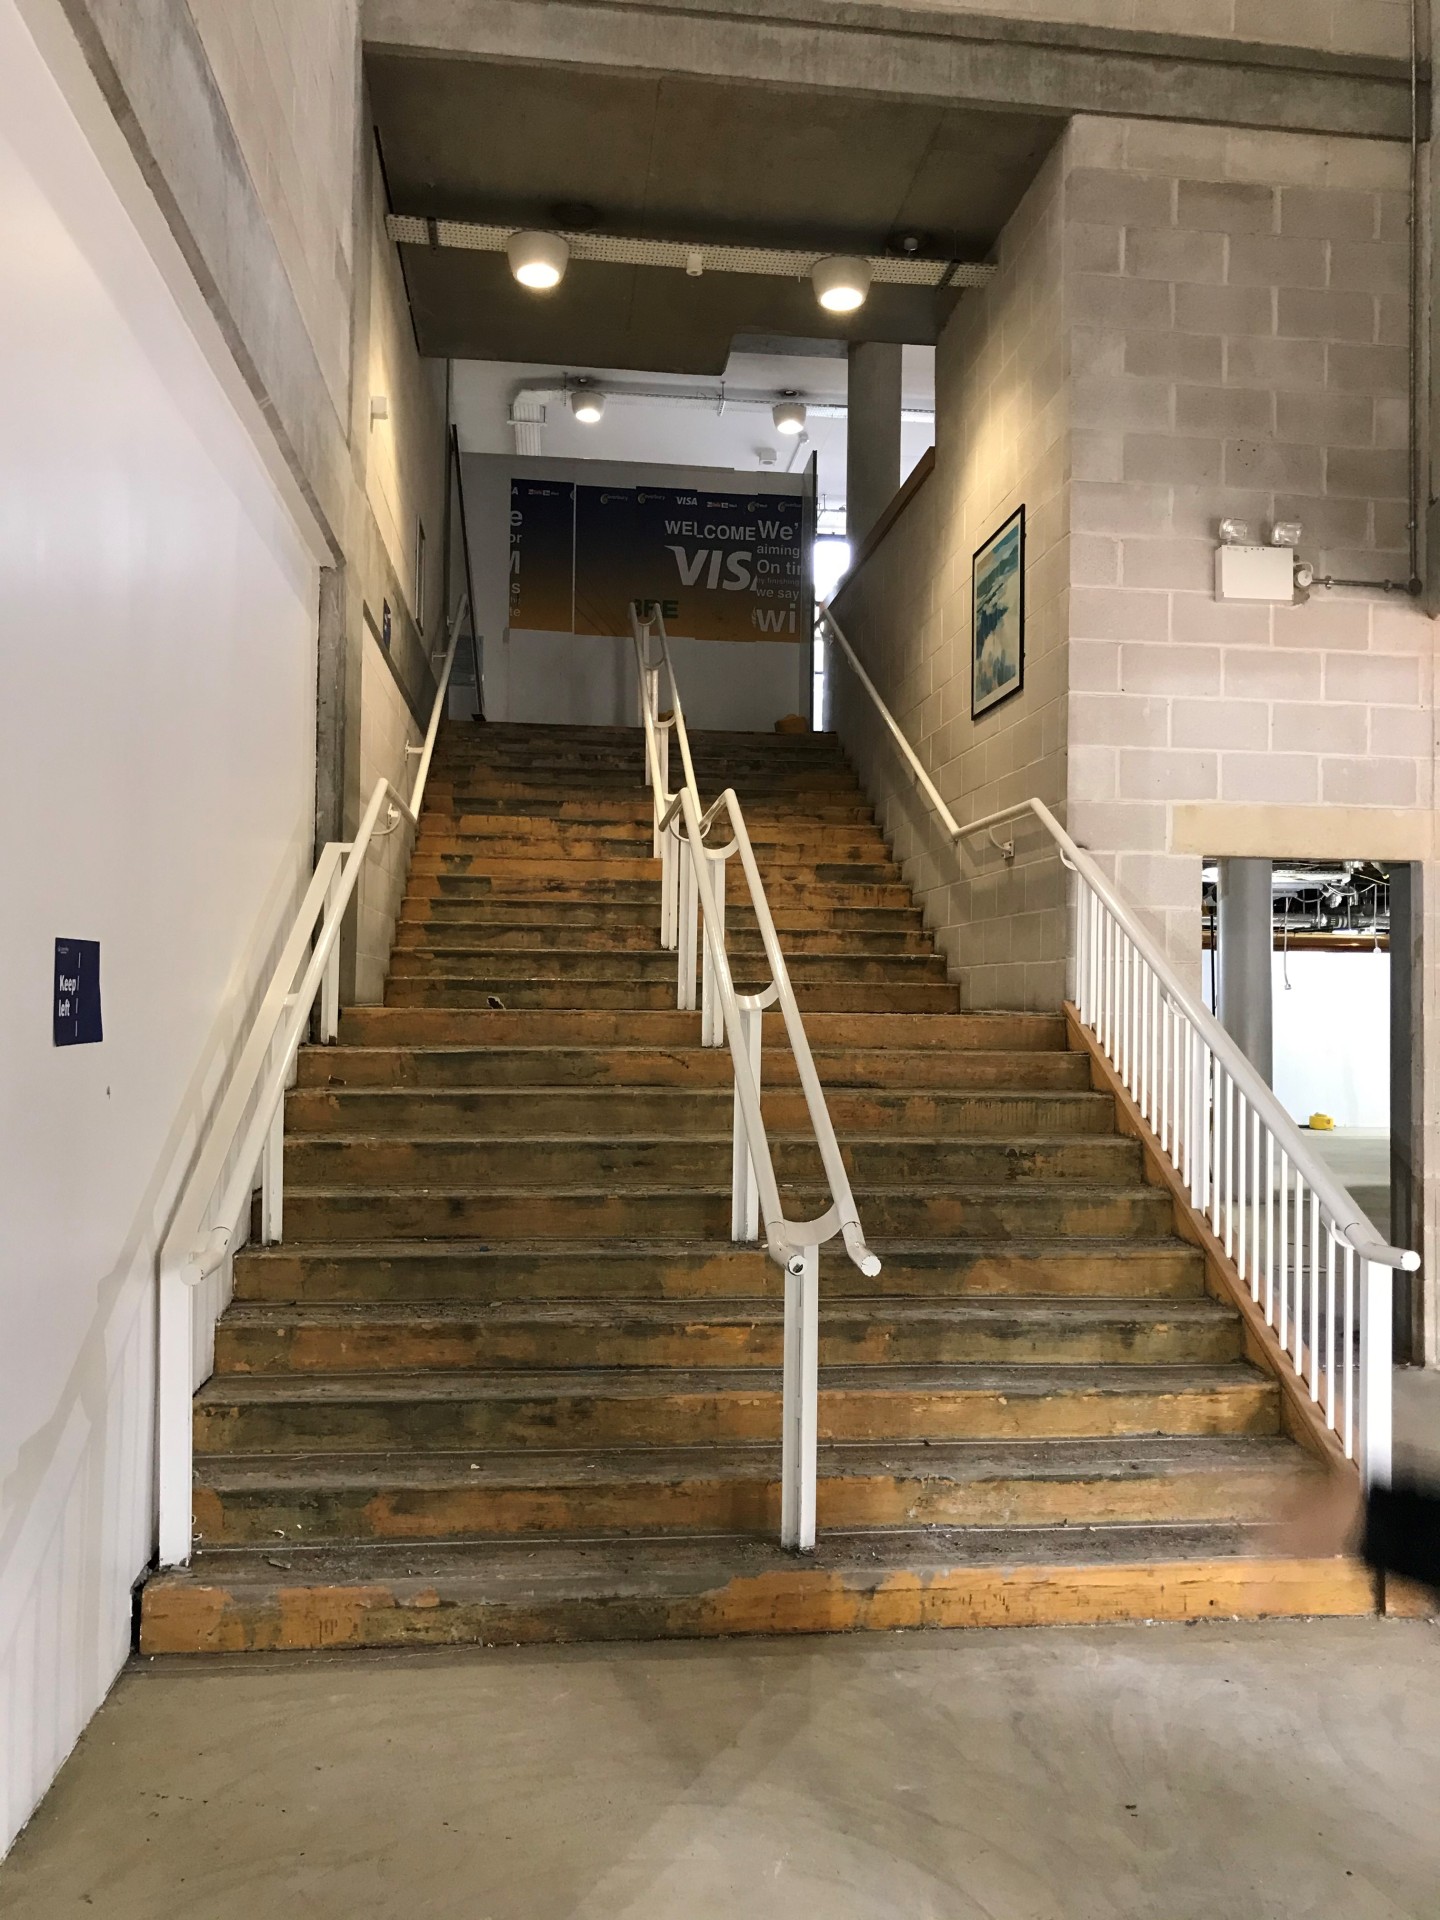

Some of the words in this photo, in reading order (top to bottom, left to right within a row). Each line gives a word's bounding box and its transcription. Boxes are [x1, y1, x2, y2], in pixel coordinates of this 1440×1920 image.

[676, 496, 698, 506] VISA
[664, 520, 756, 541] WELCOME
[757, 543, 800, 559] aiming
[757, 559, 780, 574] On
[756, 589, 774, 598] we
[777, 589, 800, 602] say
[59, 975, 76, 995] Keep
[58, 999, 70, 1017] left
